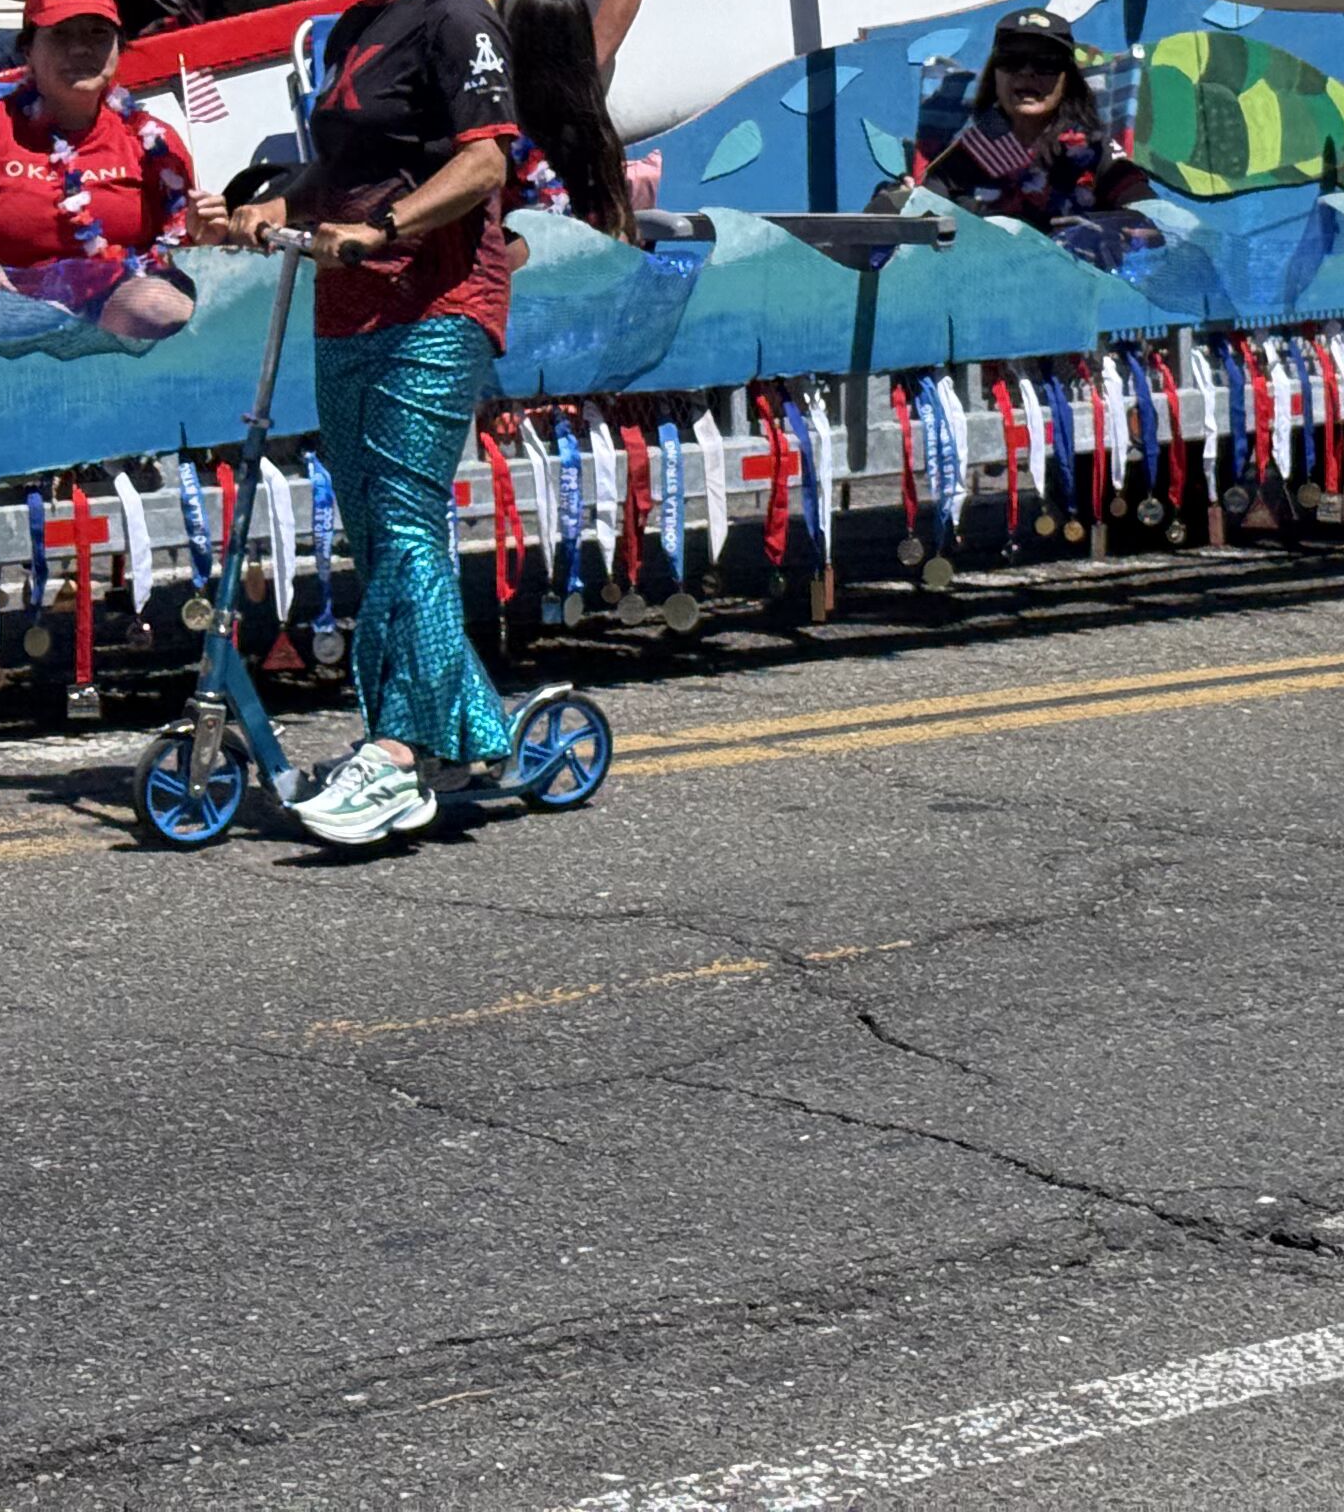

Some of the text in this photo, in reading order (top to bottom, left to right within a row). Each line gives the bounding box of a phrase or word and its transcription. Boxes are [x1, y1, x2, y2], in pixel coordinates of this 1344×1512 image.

[5, 160, 127, 183] OKAANI
[664, 441, 678, 555] GORILLA STRONG
